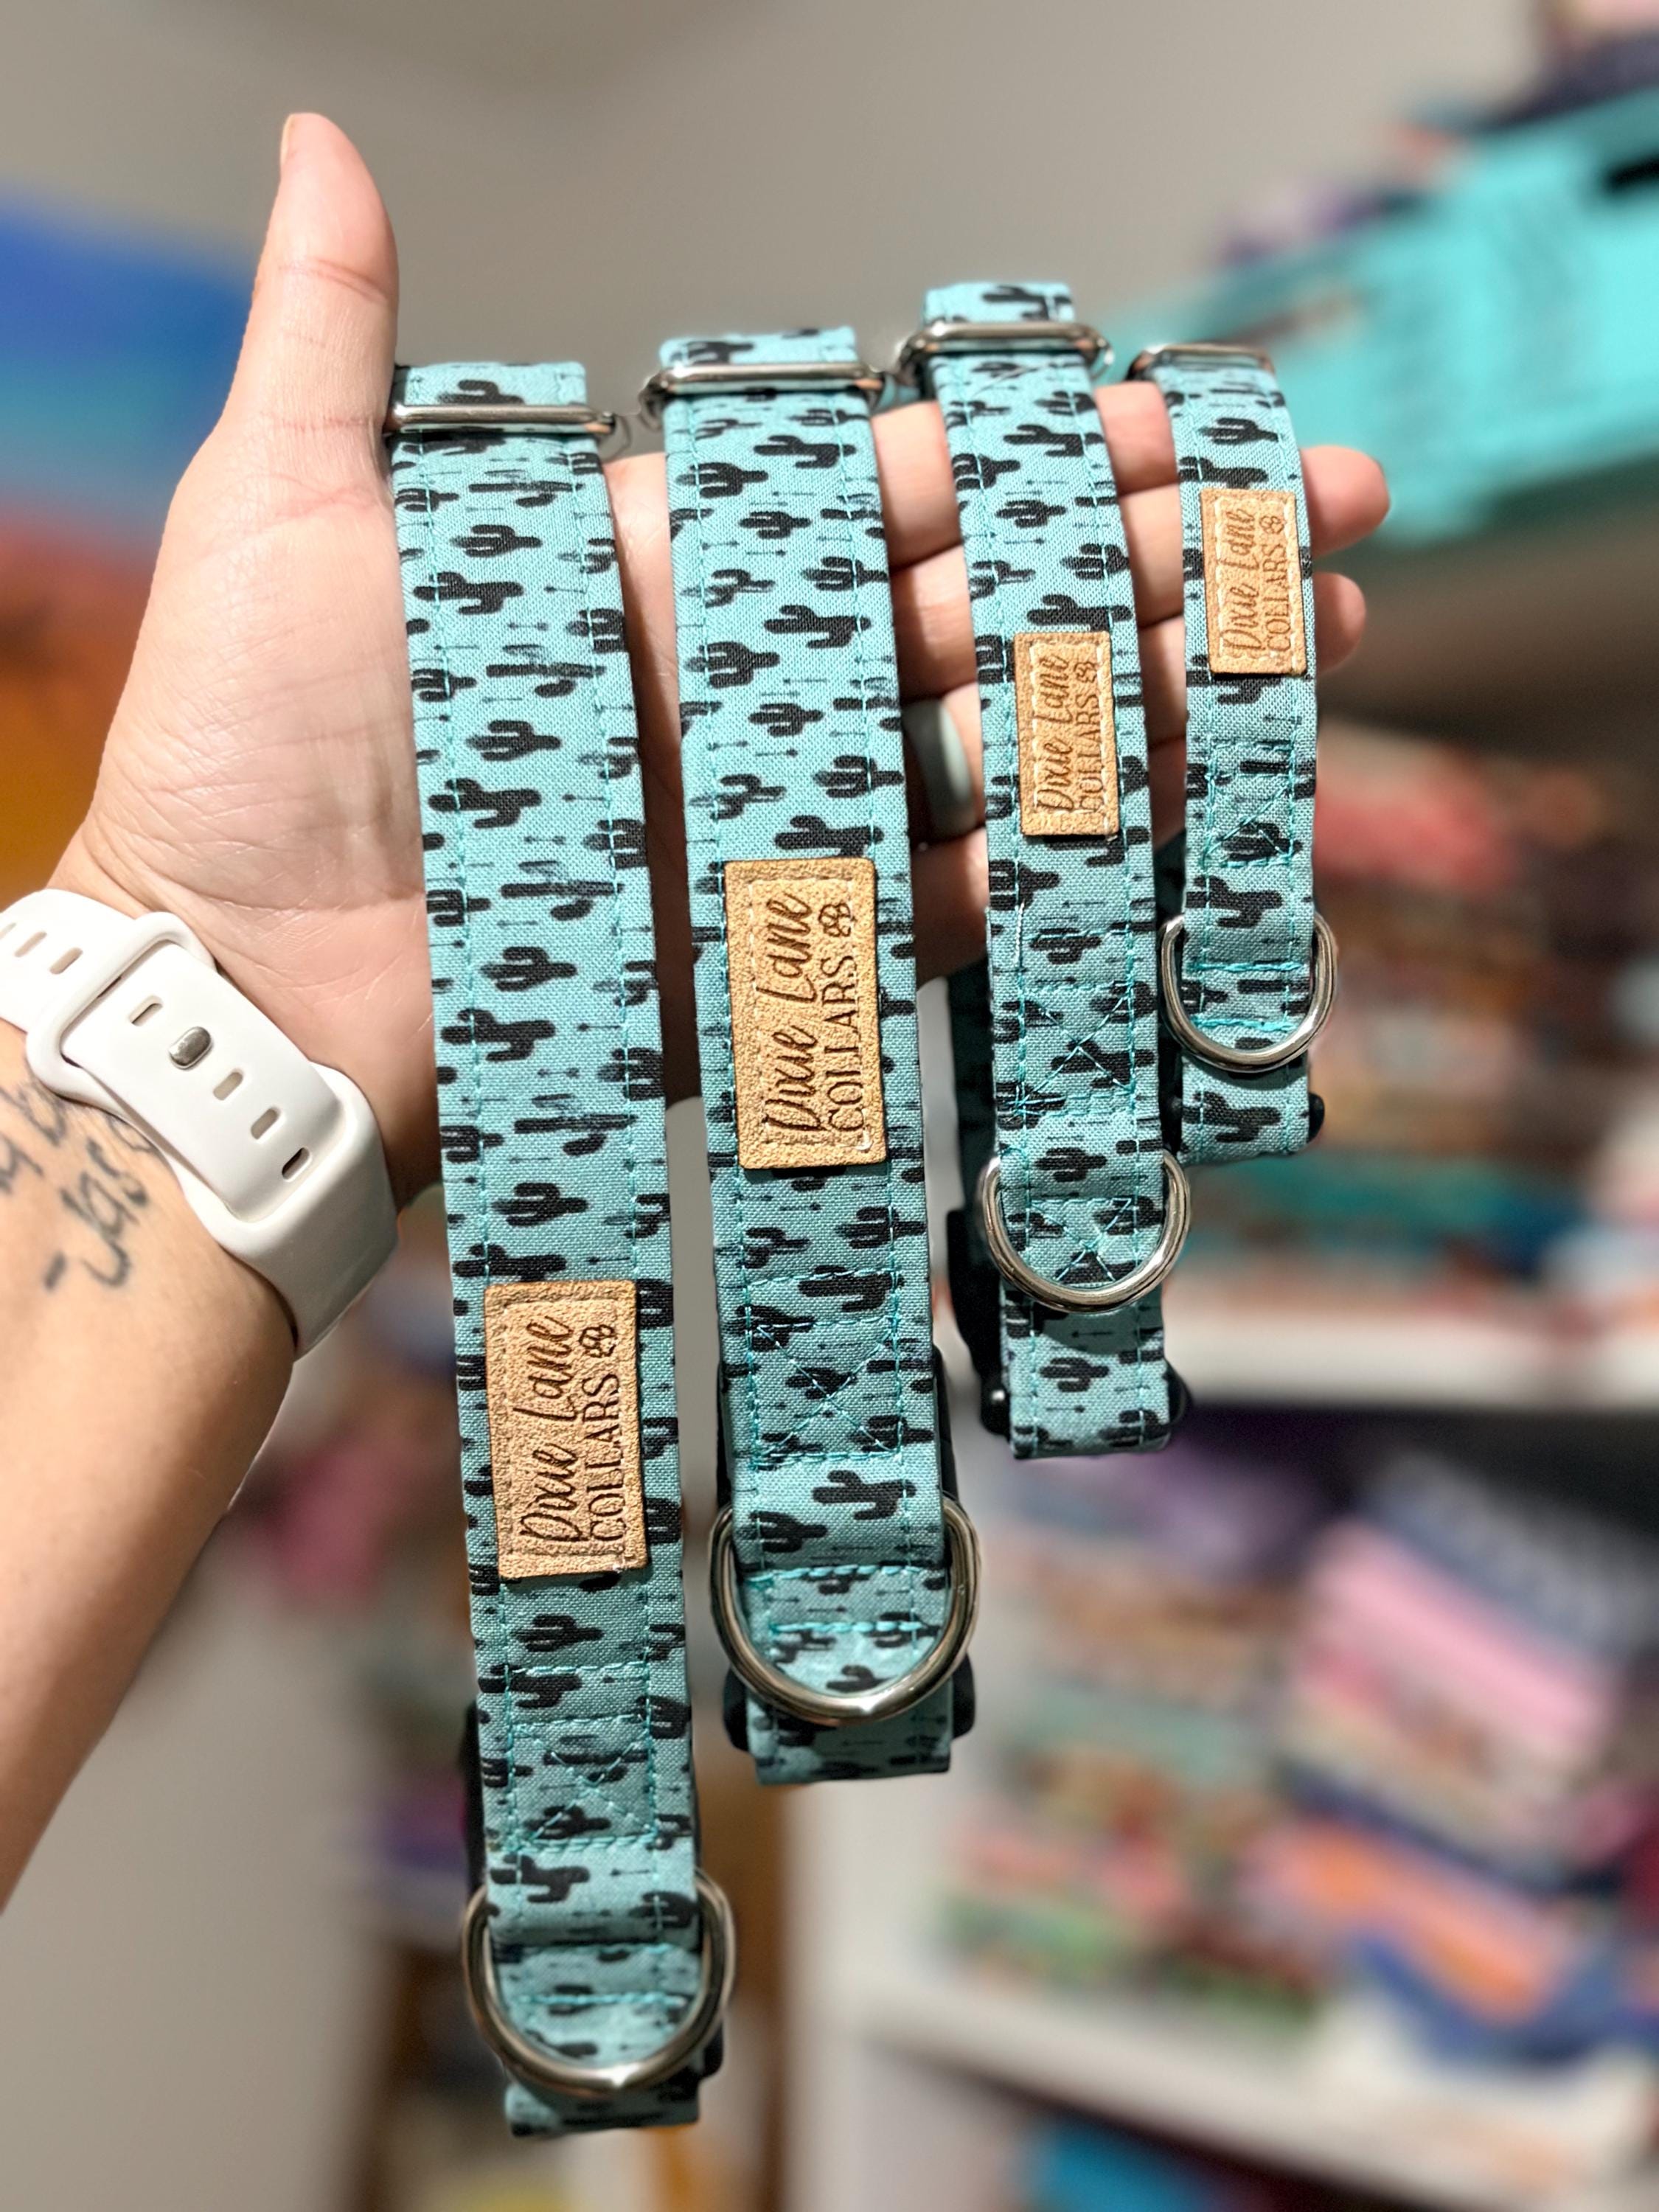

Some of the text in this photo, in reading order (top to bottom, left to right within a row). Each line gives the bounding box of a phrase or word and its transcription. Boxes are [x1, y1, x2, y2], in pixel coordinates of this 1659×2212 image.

[1219, 509, 1265, 650] Dixie Lane
[1262, 543, 1291, 652] COLLARS
[1033, 655, 1074, 811] Dixie Lane
[1075, 695, 1105, 810] COLLARS
[756, 893, 827, 1131] Dixie Lane
[820, 956, 865, 1131] COLLARS
[513, 1315, 588, 1543] Dixie Lane
[582, 1373, 627, 1542] COLLARS
